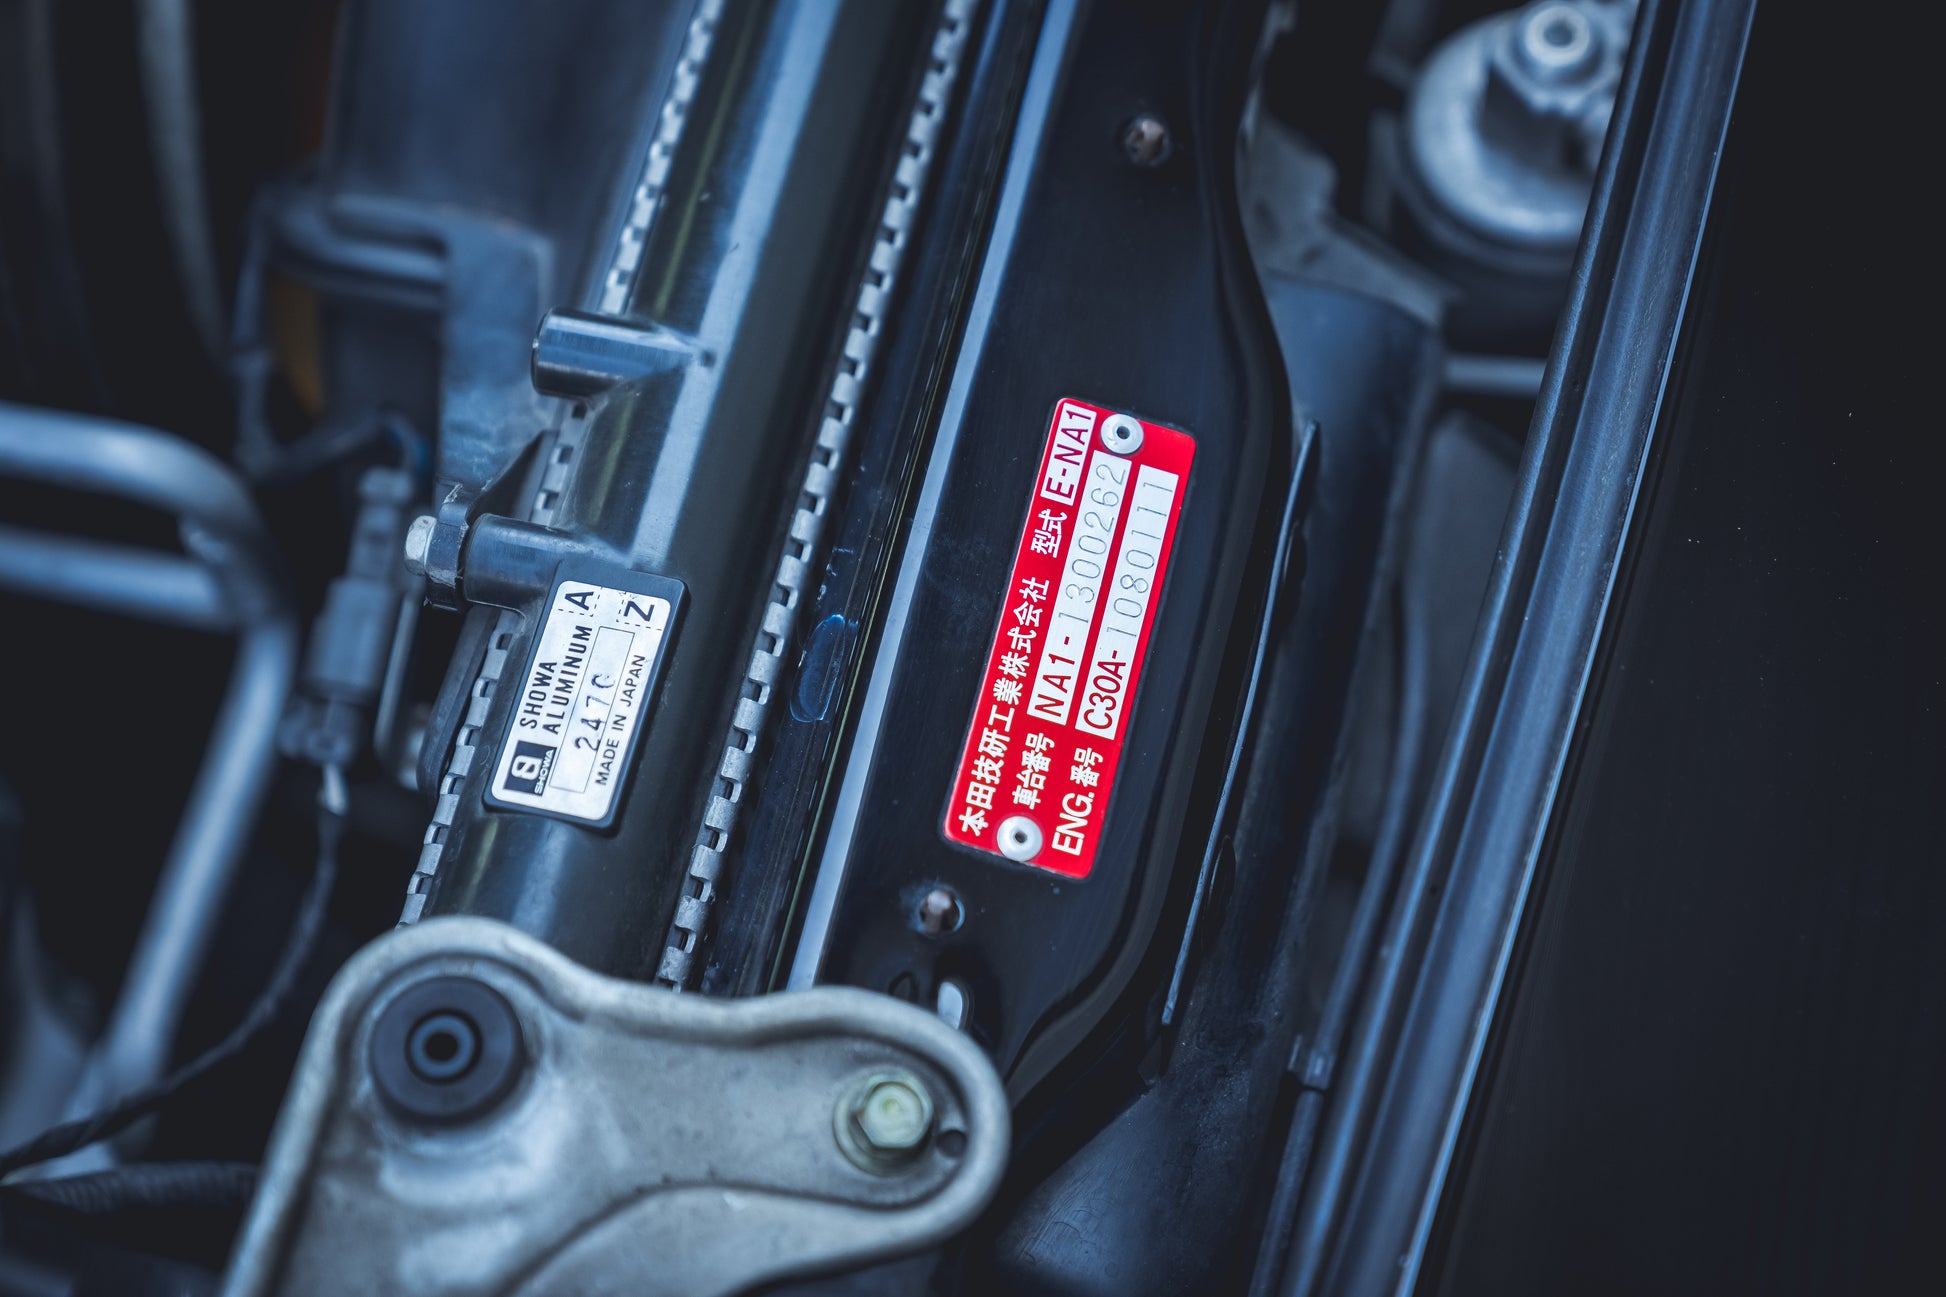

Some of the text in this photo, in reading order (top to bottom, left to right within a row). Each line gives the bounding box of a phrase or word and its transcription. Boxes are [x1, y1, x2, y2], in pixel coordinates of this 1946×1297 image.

[565, 591, 594, 611] A
[624, 600, 655, 622] Z
[958, 410, 1092, 837] 本田技研工業株式会社 型式 E-NA1
[519, 661, 557, 729] SHOWA
[542, 625, 592, 735] ALUMINUM
[595, 655, 646, 786] MADE IN JAPAN
[534, 749, 554, 794] SHOWA
[1012, 732, 1055, 810] 車台番号
